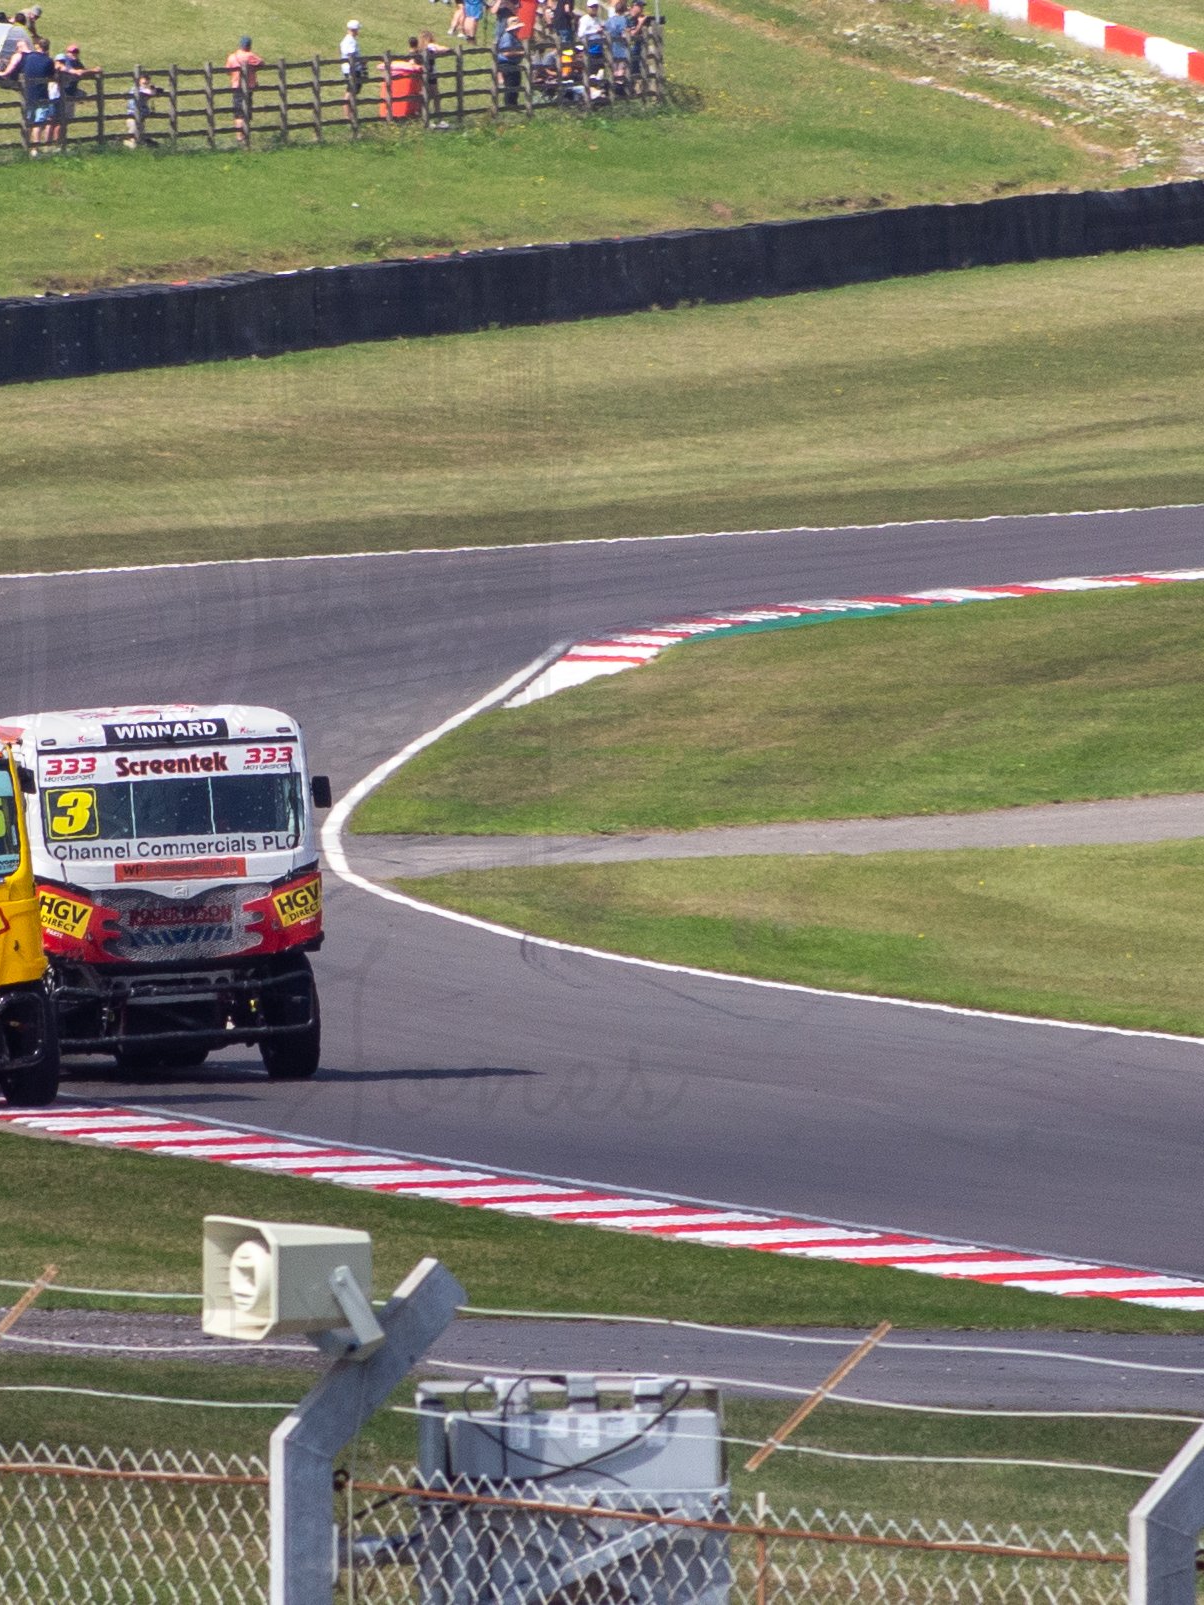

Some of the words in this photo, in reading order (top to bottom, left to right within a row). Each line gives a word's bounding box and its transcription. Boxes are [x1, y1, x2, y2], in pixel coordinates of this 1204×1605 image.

[114, 721, 218, 740] WINNARD
[115, 751, 229, 778] Screentek
[244, 746, 293, 765] 333
[46, 757, 97, 776] 333
[44, 774, 96, 782] MOTORSPORT
[52, 791, 93, 835] 3
[54, 842, 131, 860] Channel
[137, 835, 257, 857] Commercials
[123, 865, 144, 876] WP
[276, 882, 318, 916] HGV
[40, 895, 89, 925] HGV
[289, 901, 319, 921] DIRECT
[41, 915, 76, 932] DIRECT
